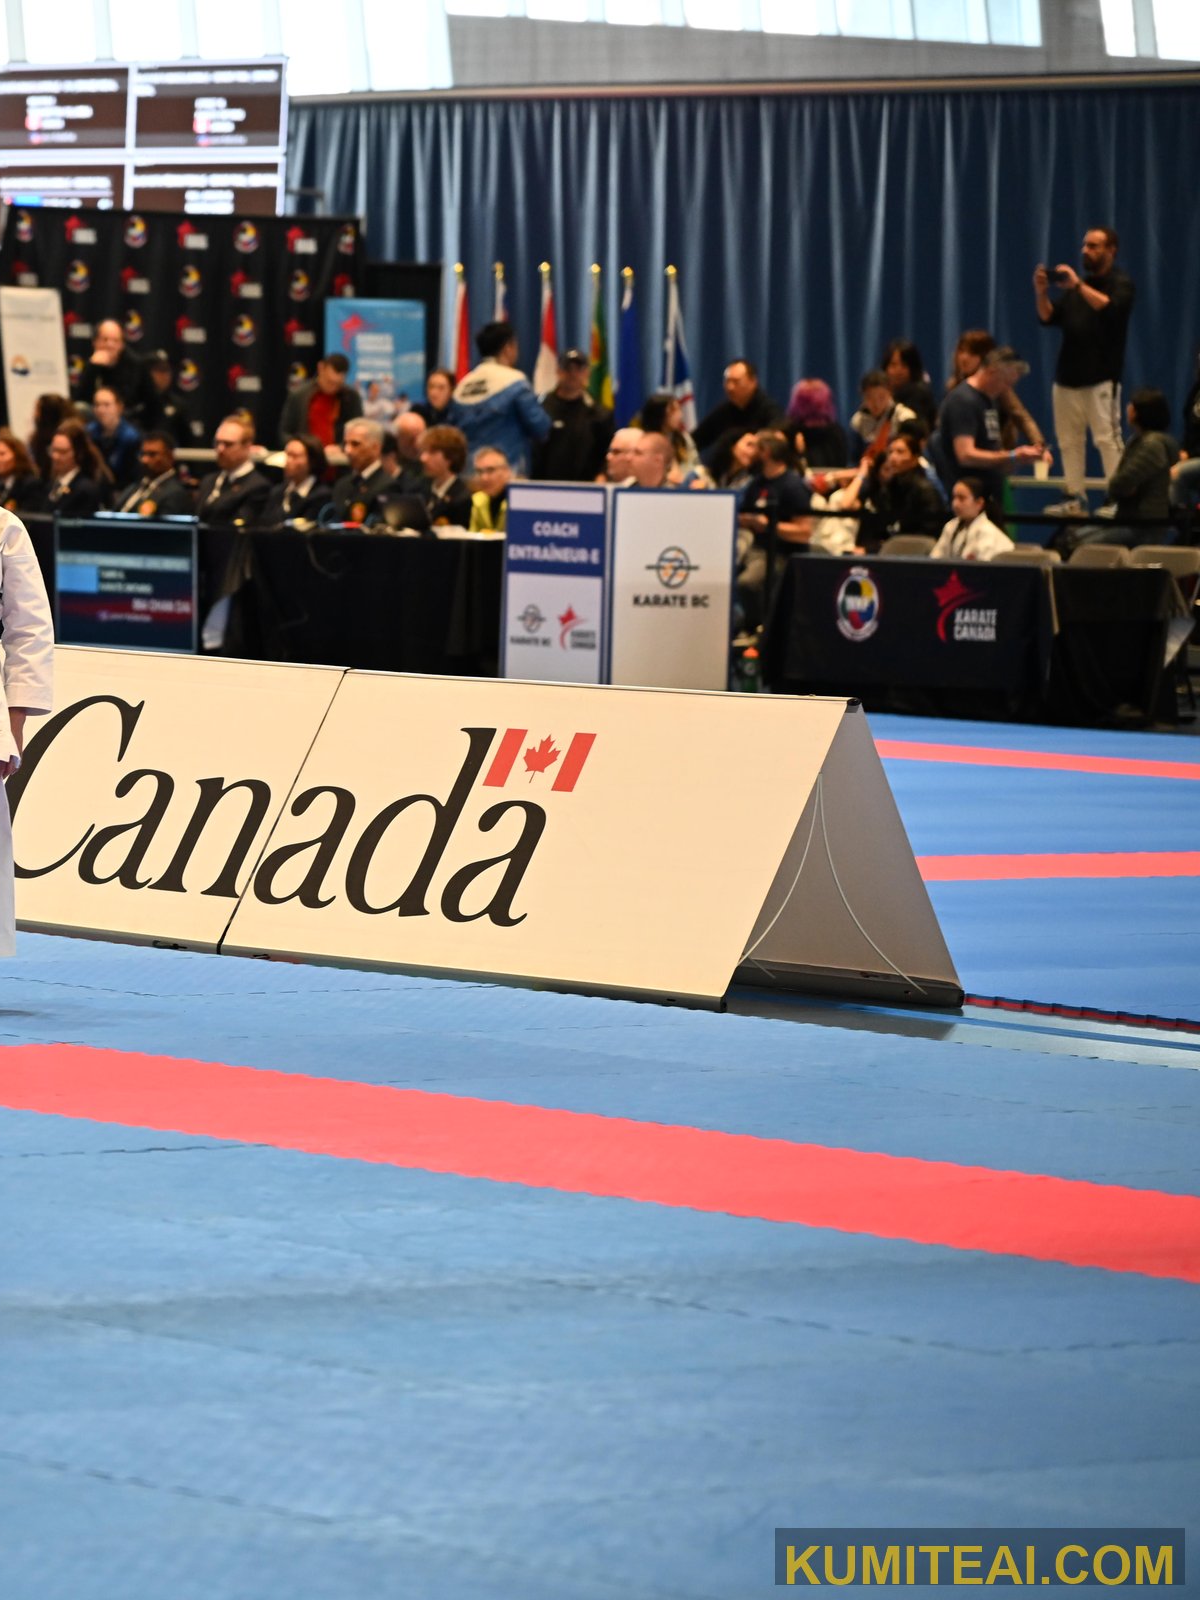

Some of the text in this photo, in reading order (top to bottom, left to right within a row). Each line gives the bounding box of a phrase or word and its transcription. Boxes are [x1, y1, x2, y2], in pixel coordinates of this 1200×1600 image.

[532, 521, 579, 538] COACH
[633, 594, 709, 608] KARATE BC
[954, 608, 997, 624] KARATE
[953, 624, 997, 641] CANADA
[4, 694, 547, 928] Canada
